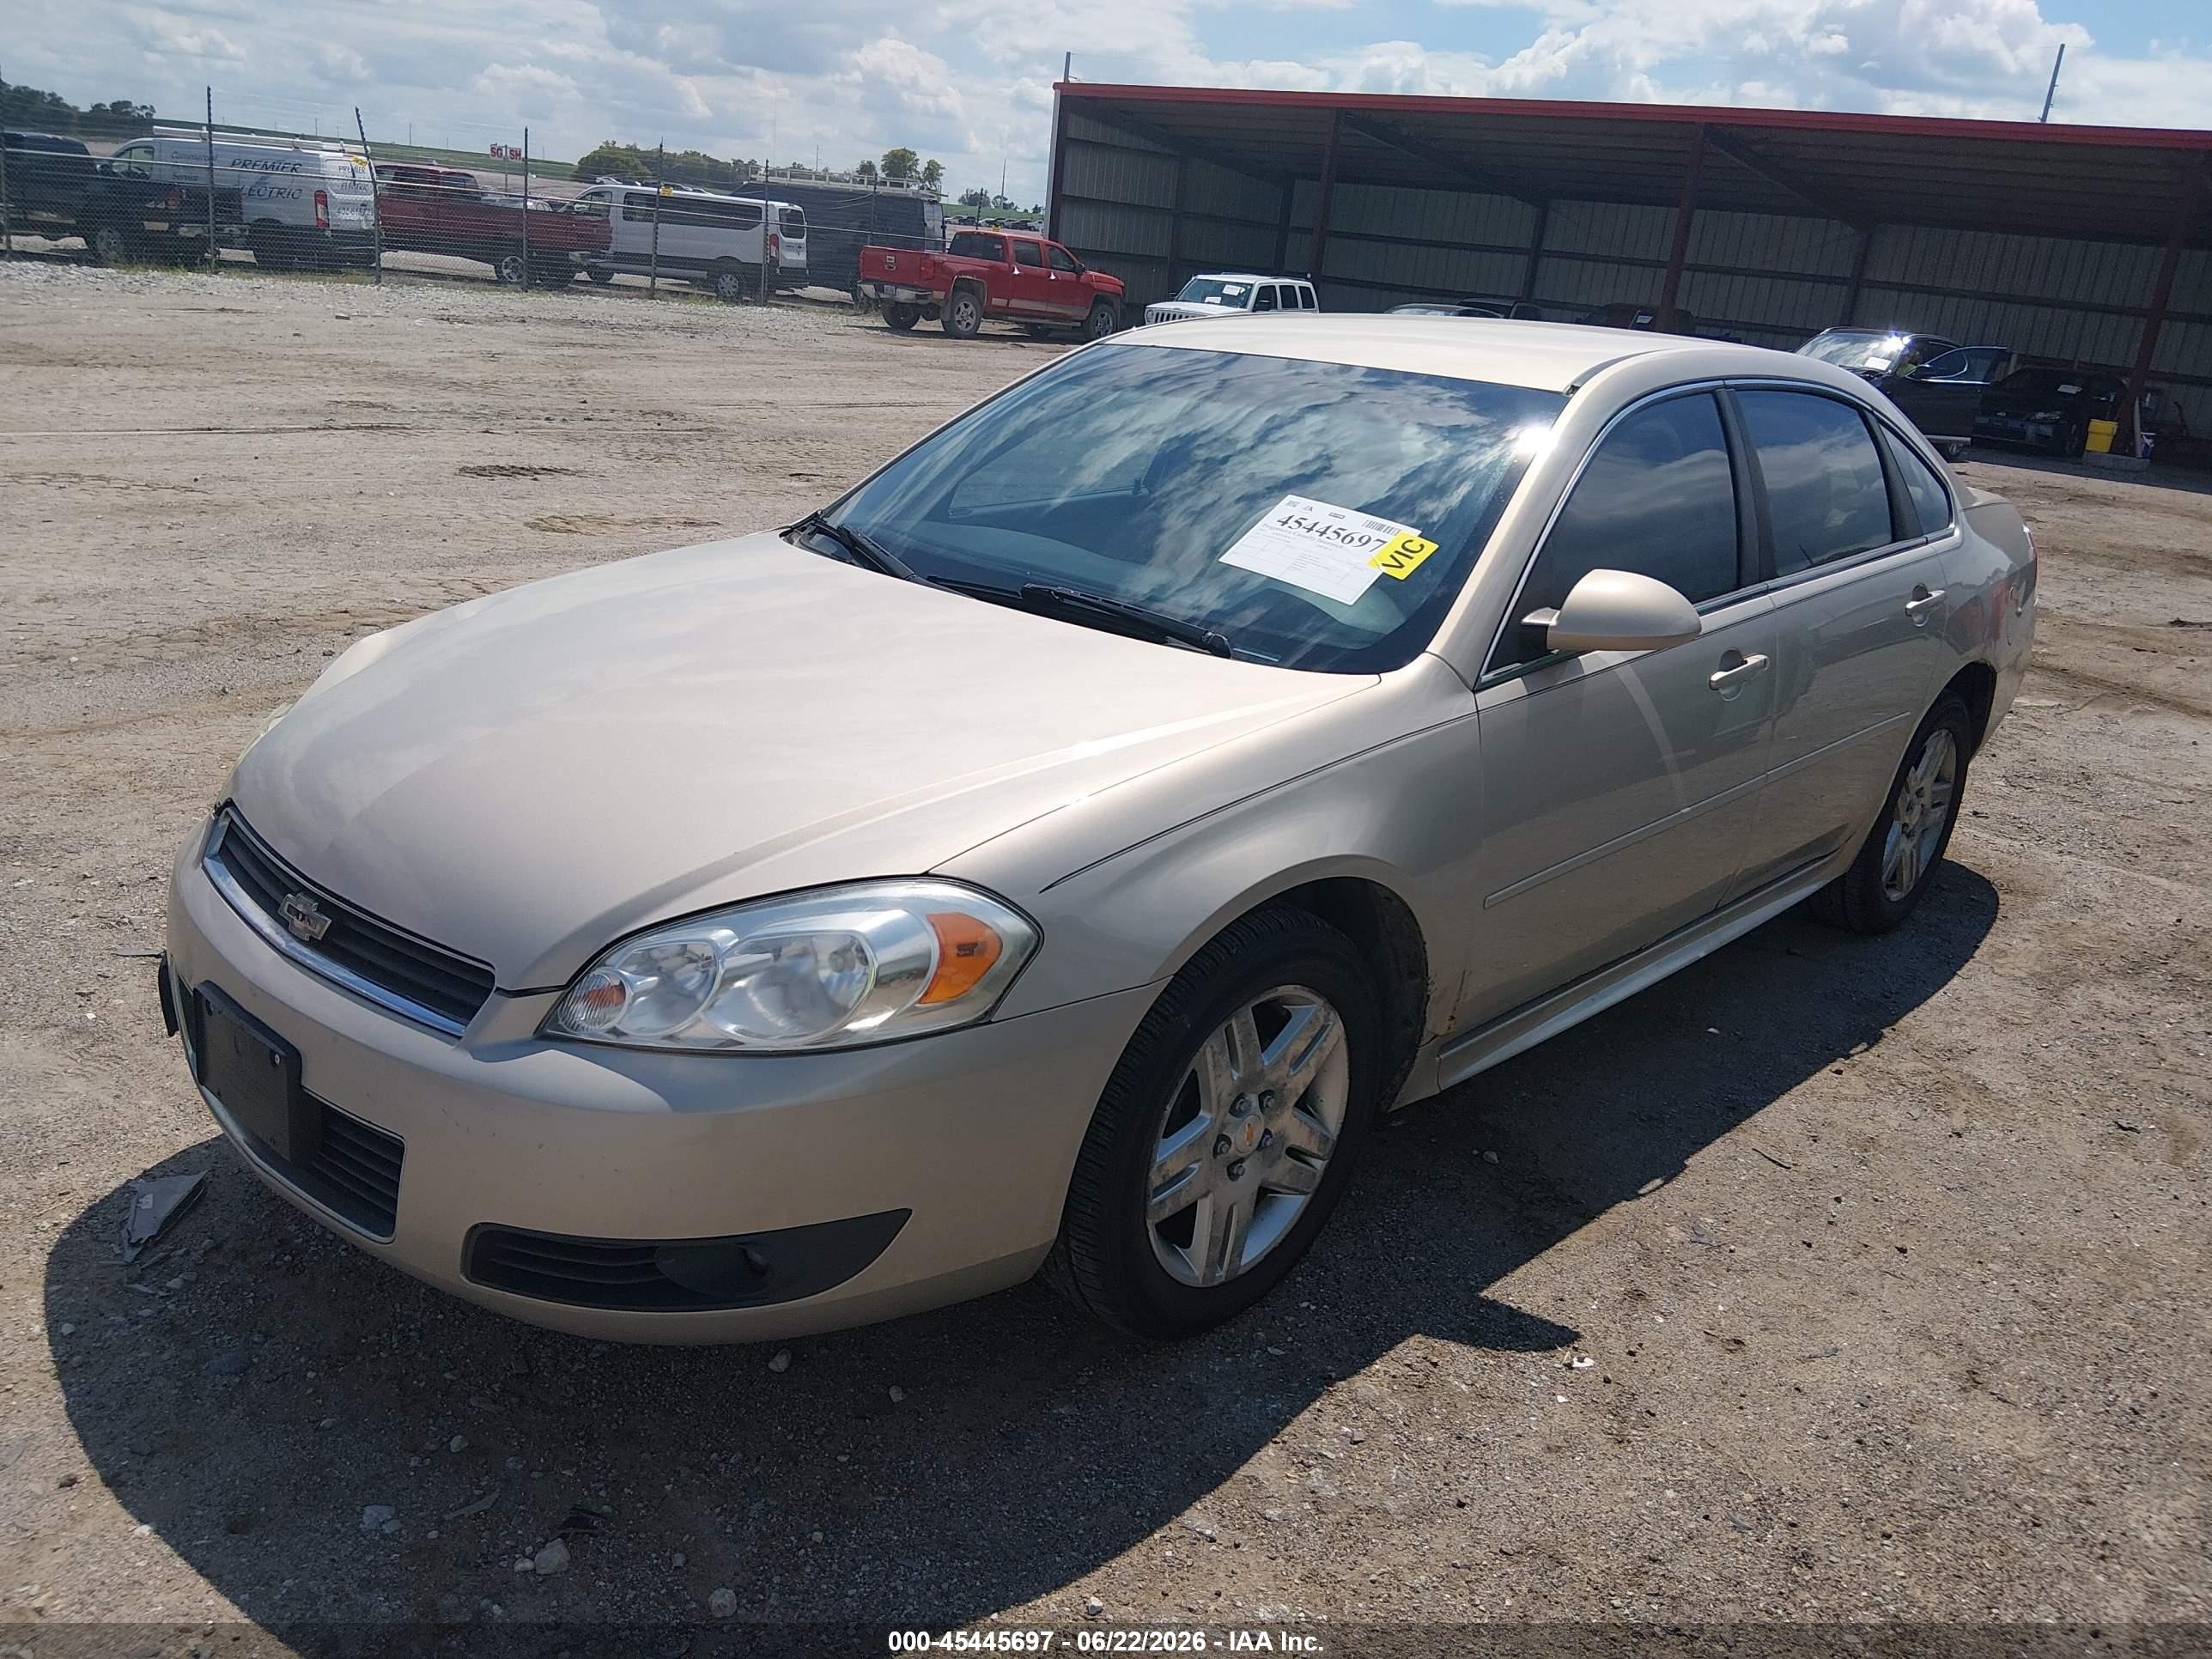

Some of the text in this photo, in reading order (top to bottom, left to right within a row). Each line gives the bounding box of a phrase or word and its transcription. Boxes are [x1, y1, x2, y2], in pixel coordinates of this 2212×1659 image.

[230, 158, 303, 173] PREMIER
[1277, 514, 1388, 552] 45445697
[1381, 539, 1425, 571] VIC
